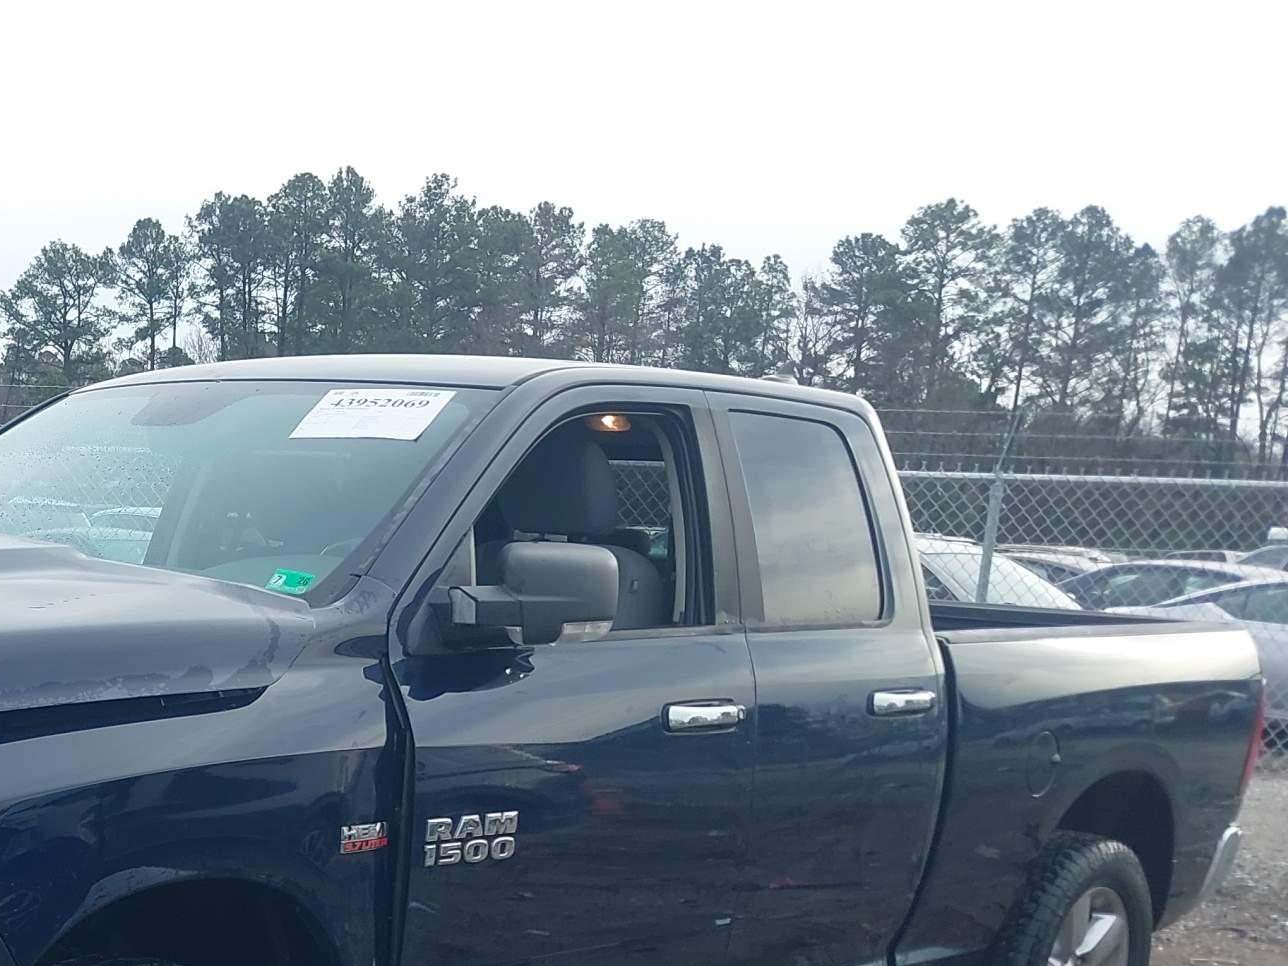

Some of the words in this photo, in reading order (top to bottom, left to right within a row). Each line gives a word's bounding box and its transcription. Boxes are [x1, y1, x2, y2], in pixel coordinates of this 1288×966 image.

[330, 397, 430, 409] 43952069
[426, 810, 519, 842] RAM
[423, 836, 516, 867] 1500
